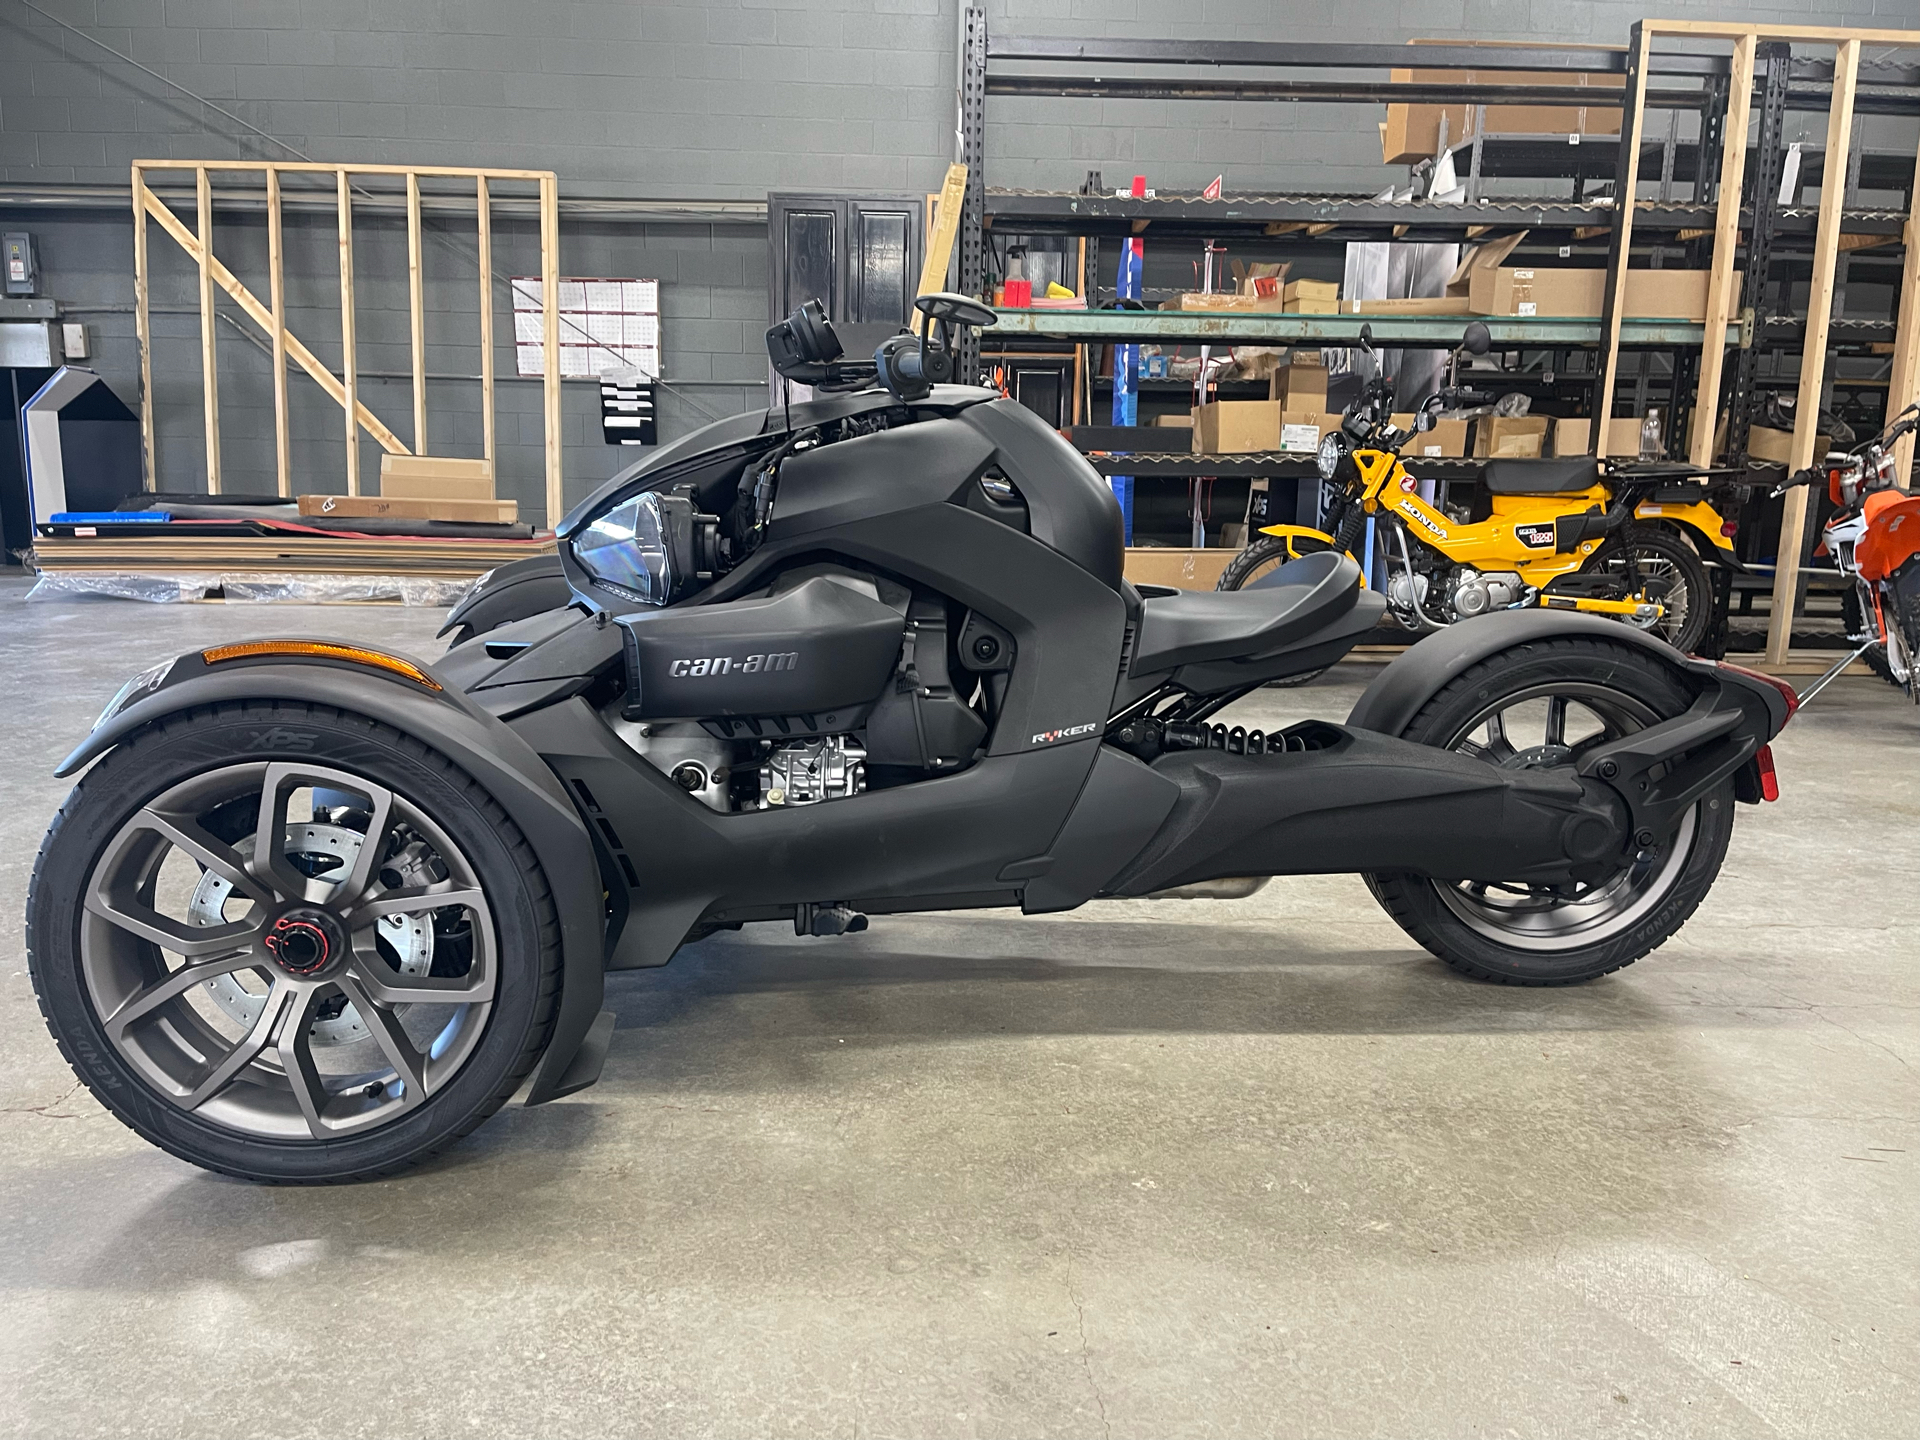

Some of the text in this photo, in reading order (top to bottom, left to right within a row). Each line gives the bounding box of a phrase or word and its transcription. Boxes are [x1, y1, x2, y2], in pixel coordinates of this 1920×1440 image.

[1252, 495, 1268, 516] XPS
[1399, 499, 1448, 540] HONDA
[1530, 532, 1553, 544] 125
[668, 652, 799, 677] can-am
[245, 727, 320, 750] XPS
[1032, 723, 1096, 743] RYKER
[1637, 901, 1679, 942] KENDA
[70, 1026, 122, 1089] KENDA
